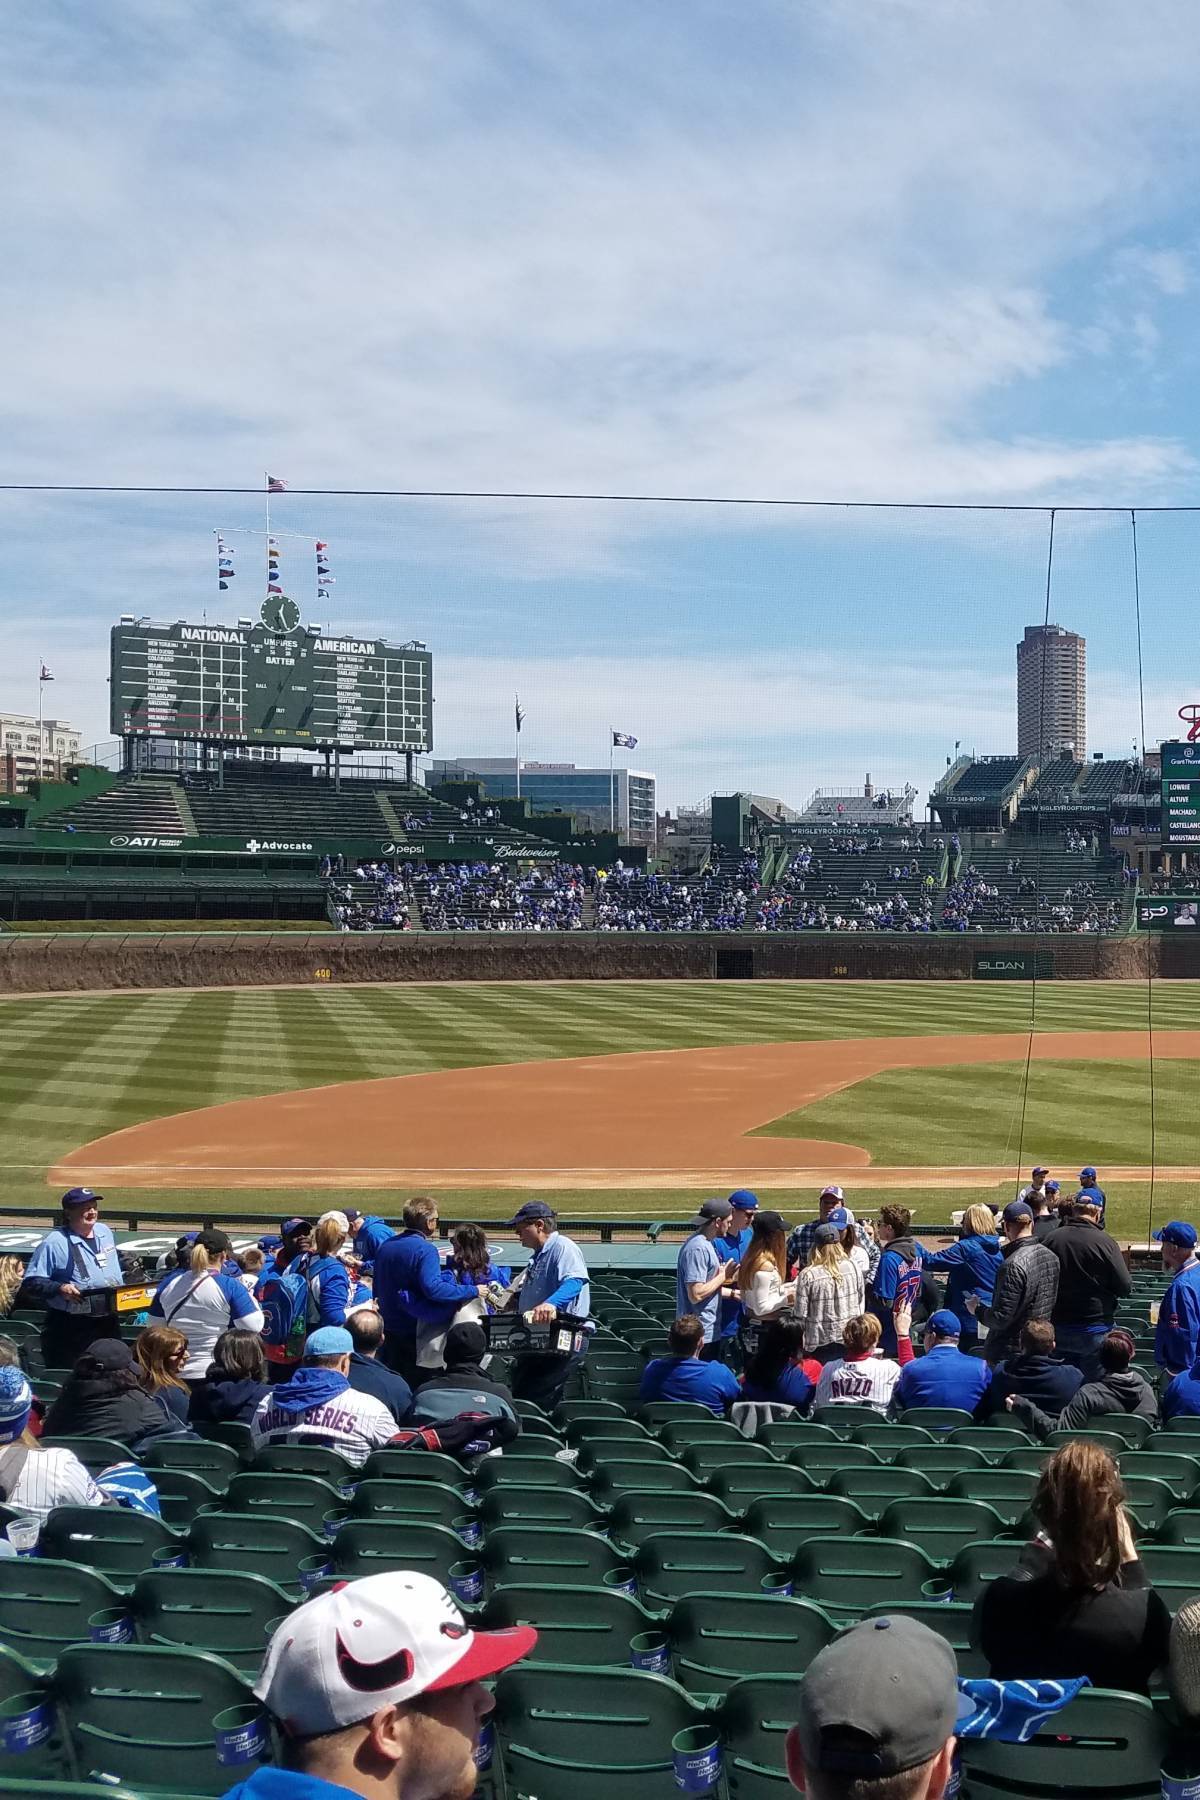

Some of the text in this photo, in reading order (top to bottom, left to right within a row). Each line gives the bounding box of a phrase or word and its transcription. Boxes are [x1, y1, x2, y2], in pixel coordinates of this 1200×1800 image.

[181, 627, 247, 644] NATIONAL
[264, 638, 298, 648] UMPIRES
[314, 640, 376, 654] AMERICAN
[266, 656, 295, 666] BATTER
[129, 838, 157, 846] ATI
[262, 841, 312, 850] Advocate
[396, 844, 424, 855] pepsi
[493, 845, 560, 857] Budweiser
[978, 962, 1025, 970] SLOAN
[314, 969, 330, 978] 400
[832, 1378, 873, 1398] RIZZO
[258, 1406, 358, 1434] WORLD SERIES
